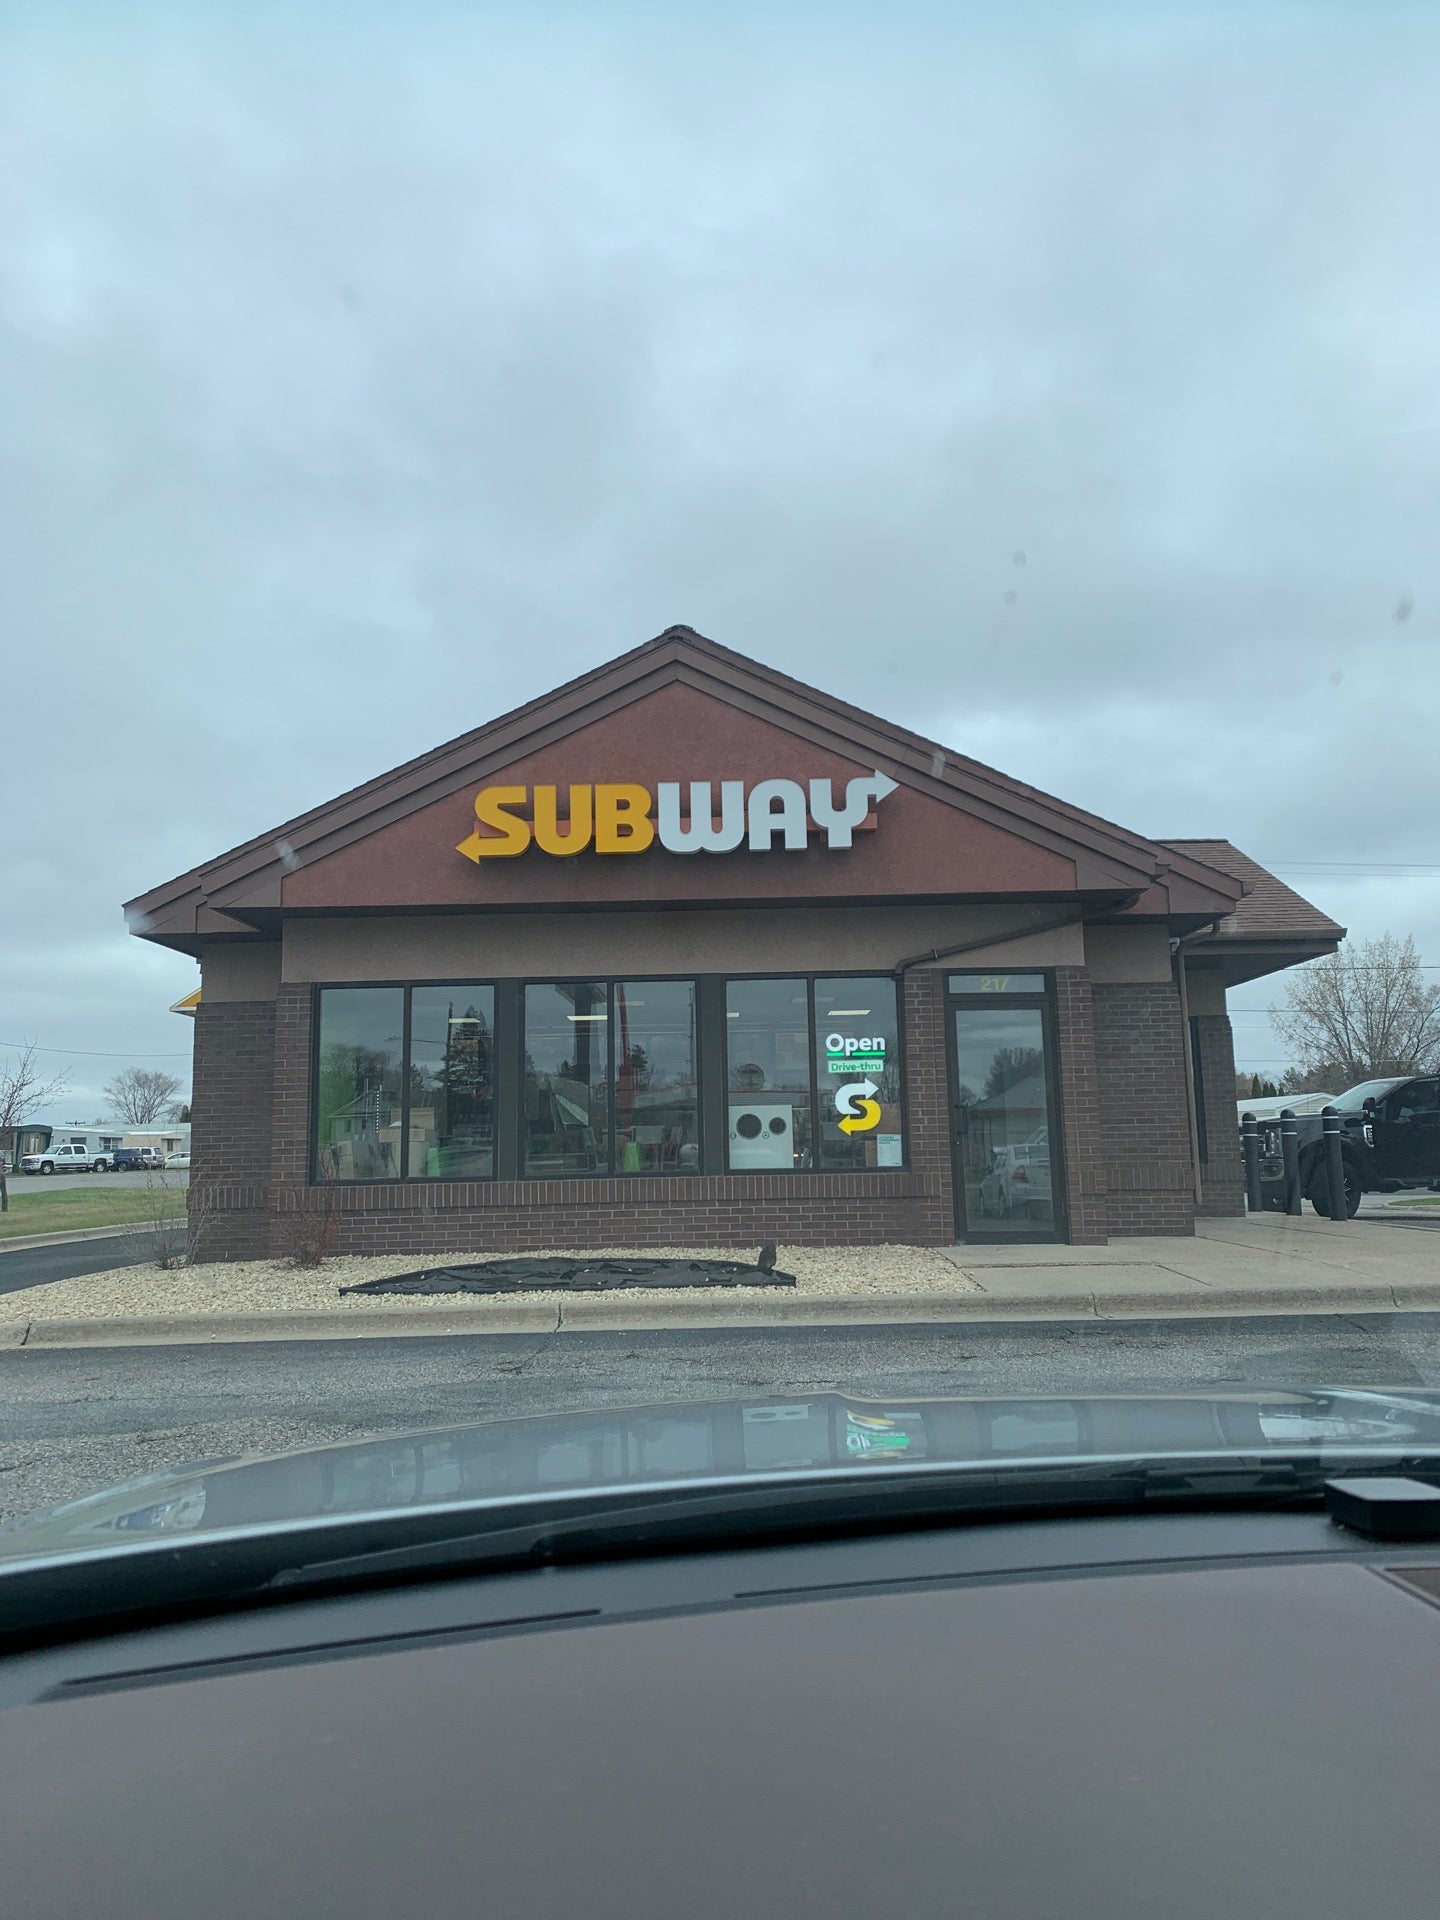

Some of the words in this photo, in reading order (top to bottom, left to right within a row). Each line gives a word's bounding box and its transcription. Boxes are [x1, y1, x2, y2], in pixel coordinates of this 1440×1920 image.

[455, 769, 900, 865] SUBWAY
[980, 976, 1010, 991] 217
[826, 1033, 886, 1057] Open
[831, 1062, 881, 1072] Drive-thru
